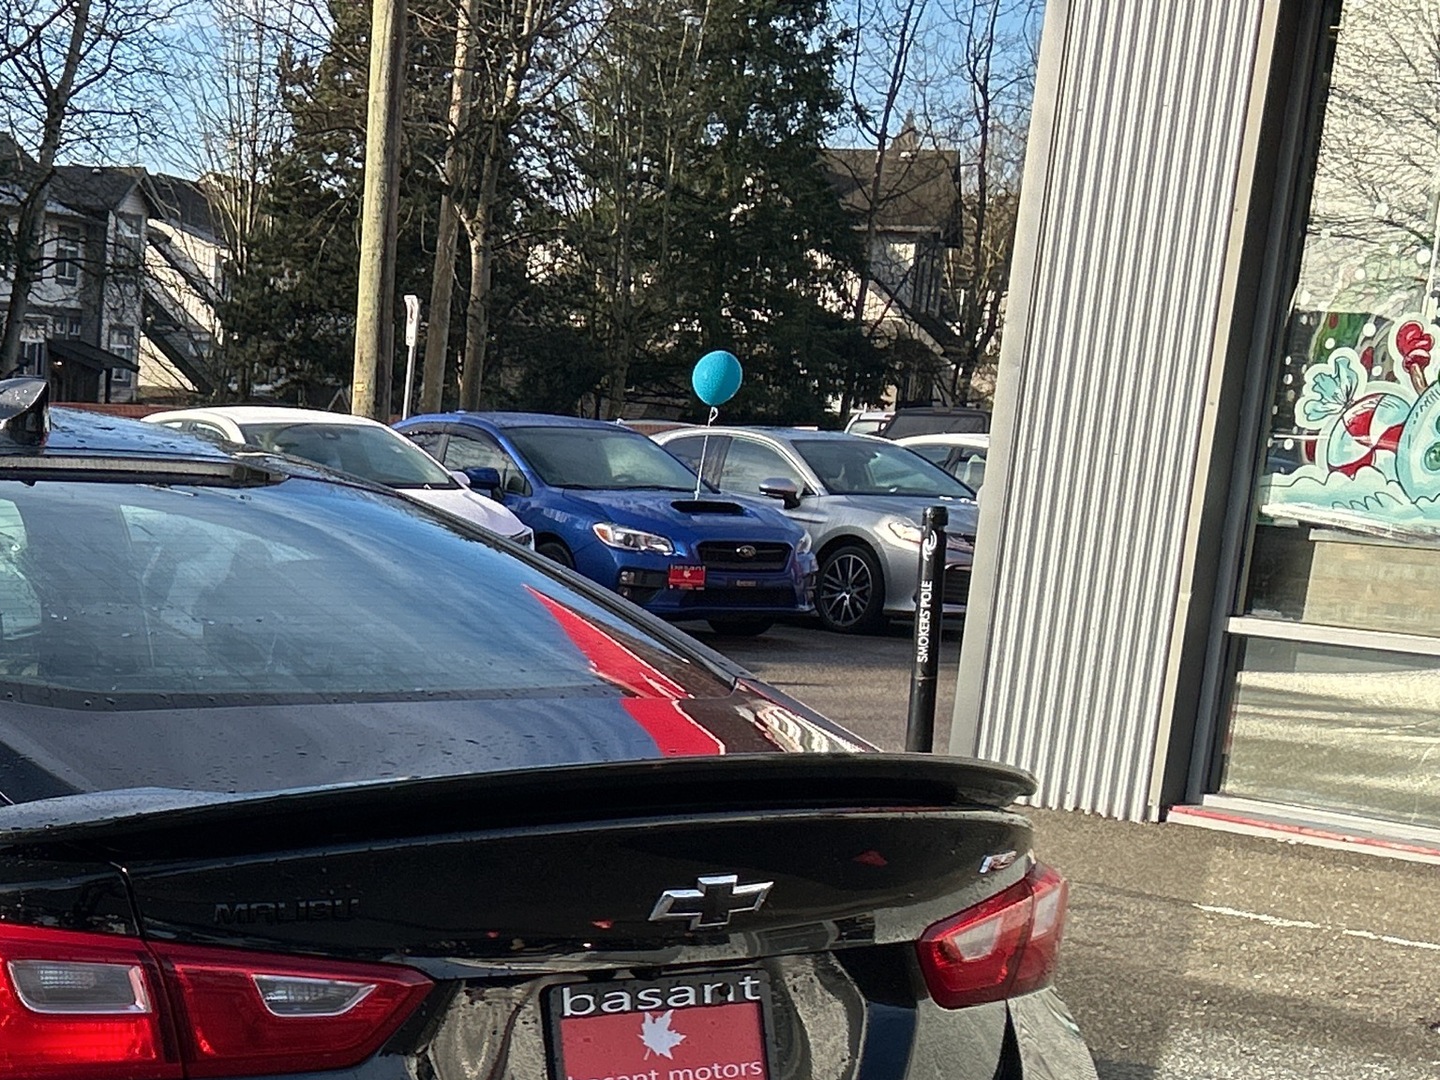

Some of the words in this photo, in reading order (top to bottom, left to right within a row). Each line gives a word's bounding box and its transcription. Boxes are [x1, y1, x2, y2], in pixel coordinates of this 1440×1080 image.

[920, 580, 933, 608] POLE
[213, 898, 360, 924] MALIBU
[562, 975, 761, 1017] basant
